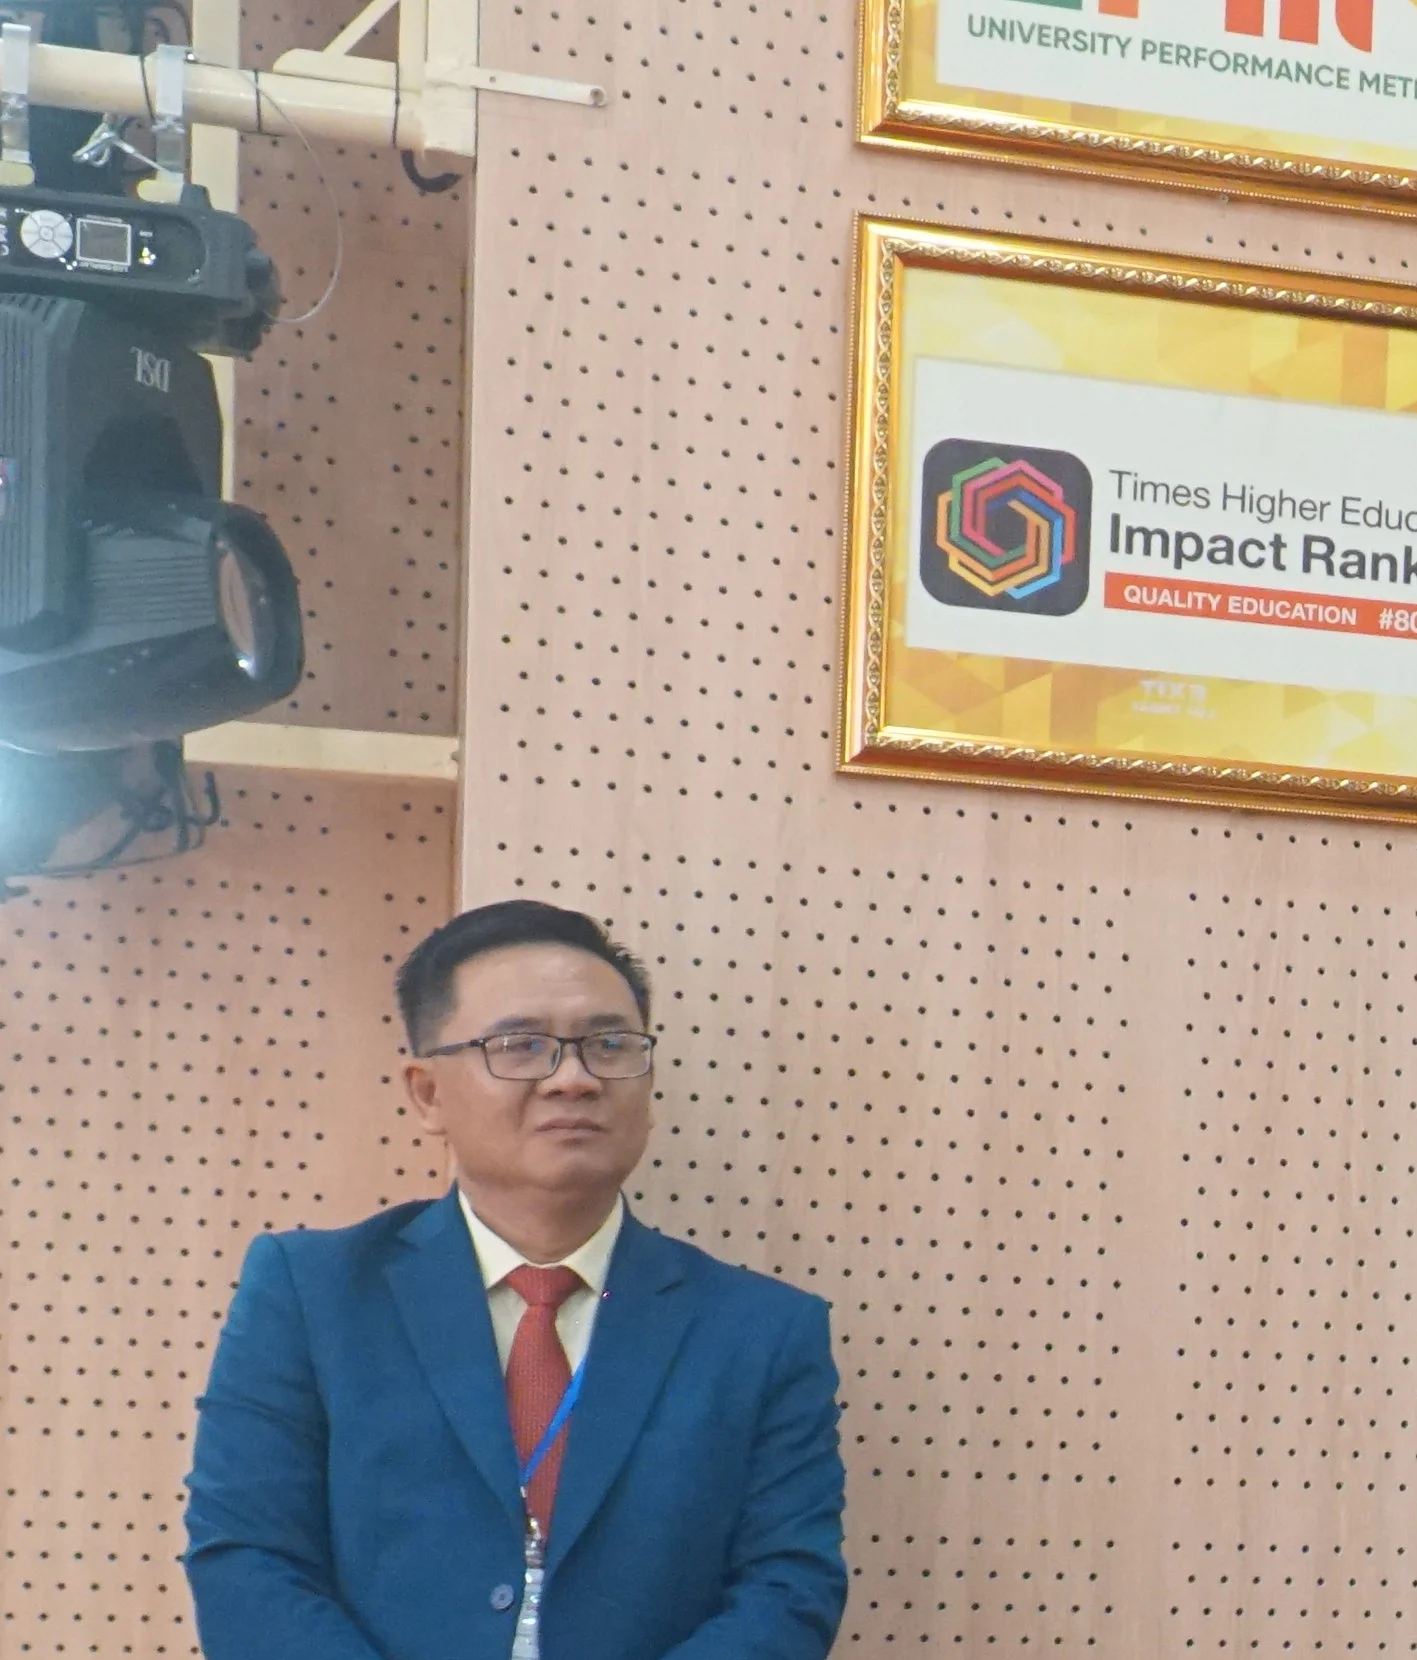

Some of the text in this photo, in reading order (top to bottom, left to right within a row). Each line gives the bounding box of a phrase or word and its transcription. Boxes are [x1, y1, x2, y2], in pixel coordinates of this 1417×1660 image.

[966, 13, 1132, 59] UNIVERSITY
[1140, 38, 1350, 91] PERFORMANCE
[1109, 469, 1211, 510] Times
[1221, 481, 1331, 524] Higher
[1109, 512, 1288, 571] Impact
[1122, 584, 1222, 613] QUALITY
[1227, 595, 1357, 627] EDUCATION
